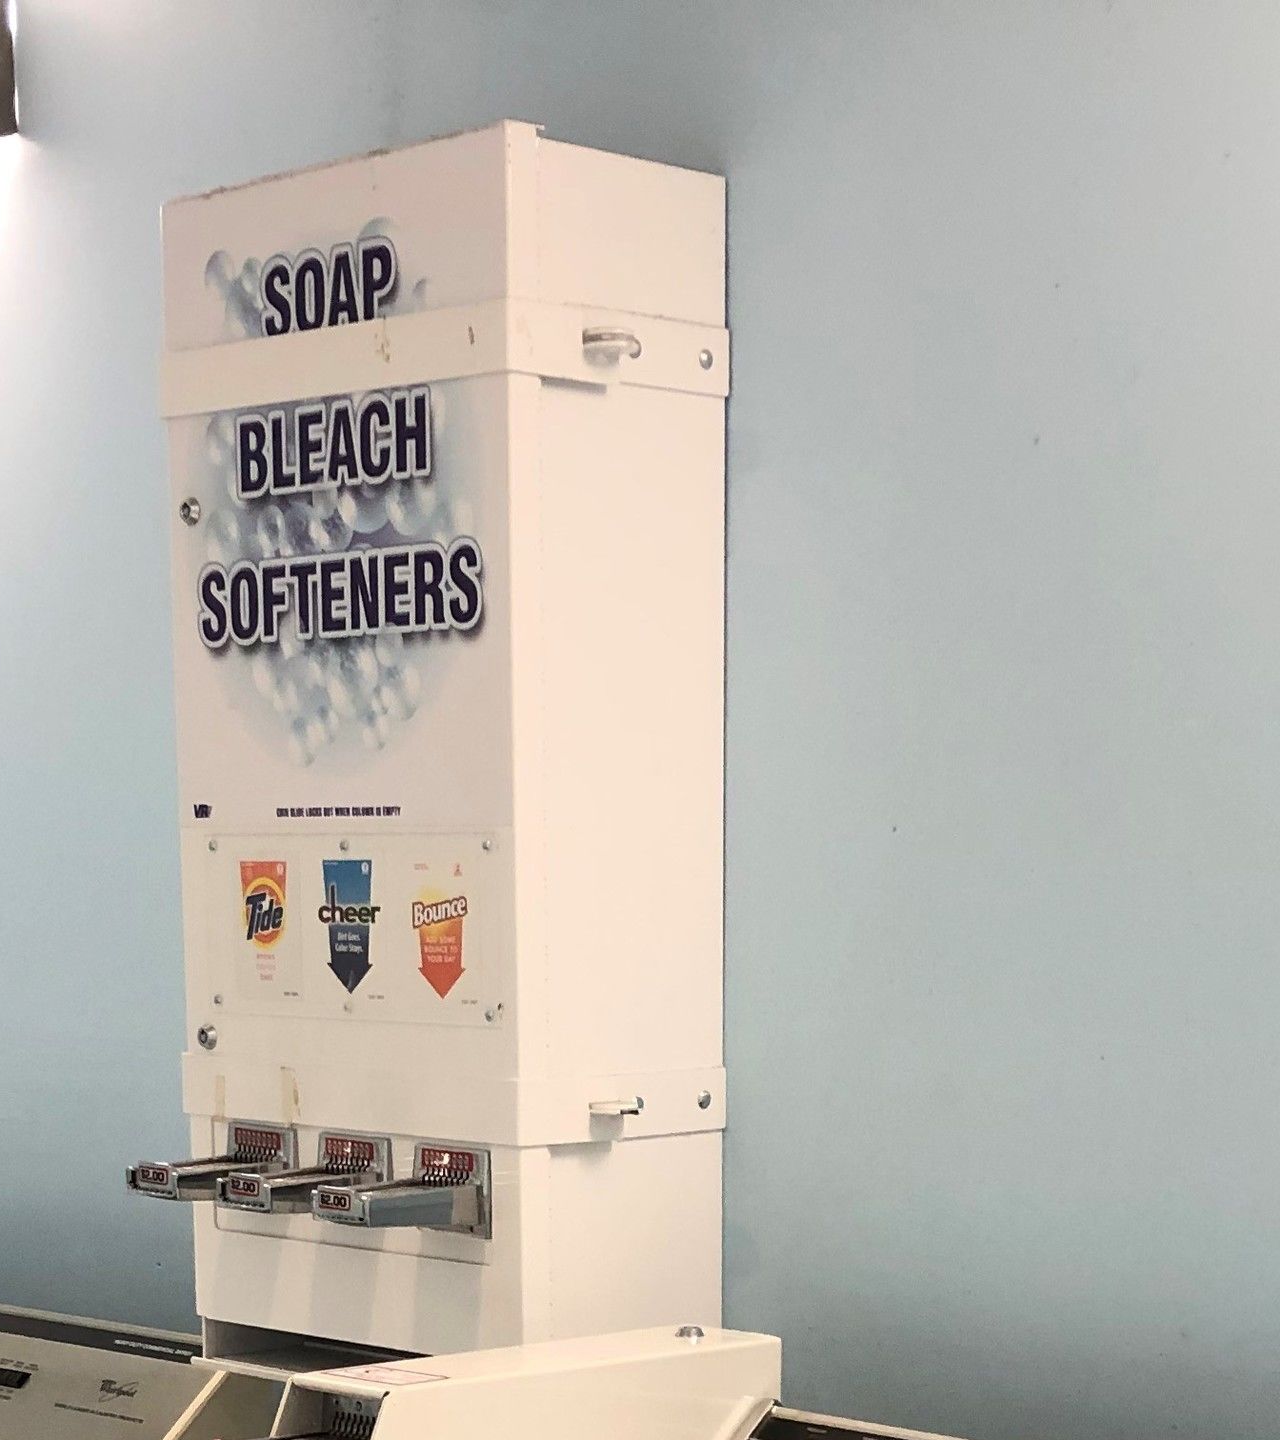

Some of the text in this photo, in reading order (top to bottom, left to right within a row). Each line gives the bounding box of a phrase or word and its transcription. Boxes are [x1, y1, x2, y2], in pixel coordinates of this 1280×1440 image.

[262, 238, 396, 336] SOAP
[237, 388, 432, 498] BLEACH
[199, 538, 483, 647] SOFTENERS
[246, 892, 284, 941] Tide
[317, 884, 380, 924] cheer
[412, 896, 468, 929] Bounce
[140, 1168, 165, 1182] $2.00
[230, 1178, 256, 1194] $2.00
[320, 1193, 348, 1208] $2.00
